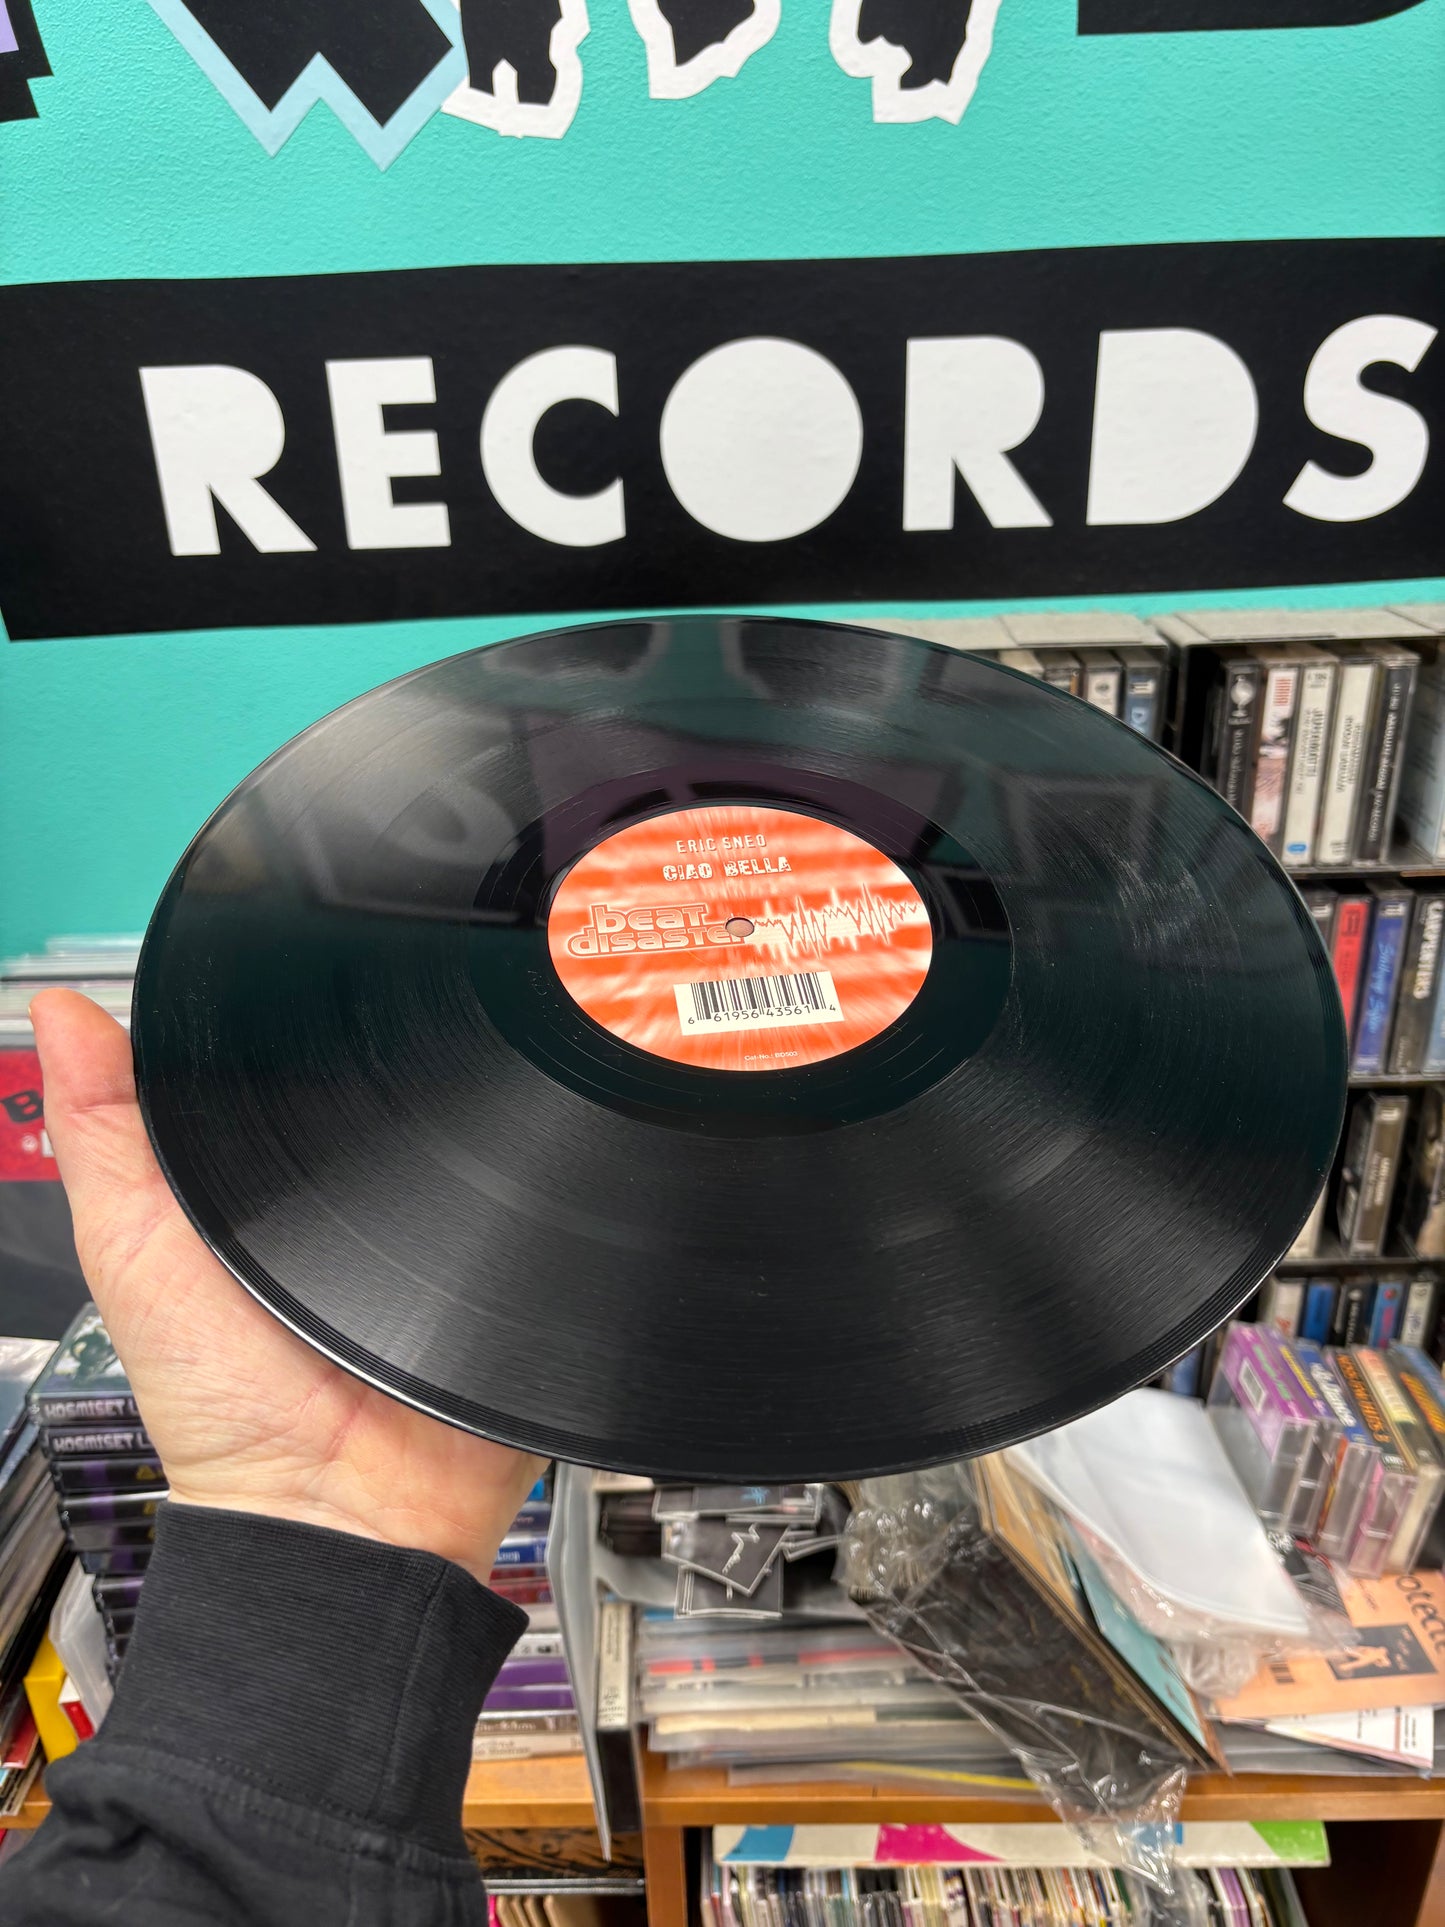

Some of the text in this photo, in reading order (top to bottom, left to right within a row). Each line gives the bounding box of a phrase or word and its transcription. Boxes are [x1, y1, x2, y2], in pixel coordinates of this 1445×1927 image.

[139, 315, 1438, 556] RECORDS
[676, 833, 767, 853] ERIC SNEO
[662, 856, 792, 881] CIAO BELLA
[592, 904, 708, 935] beat
